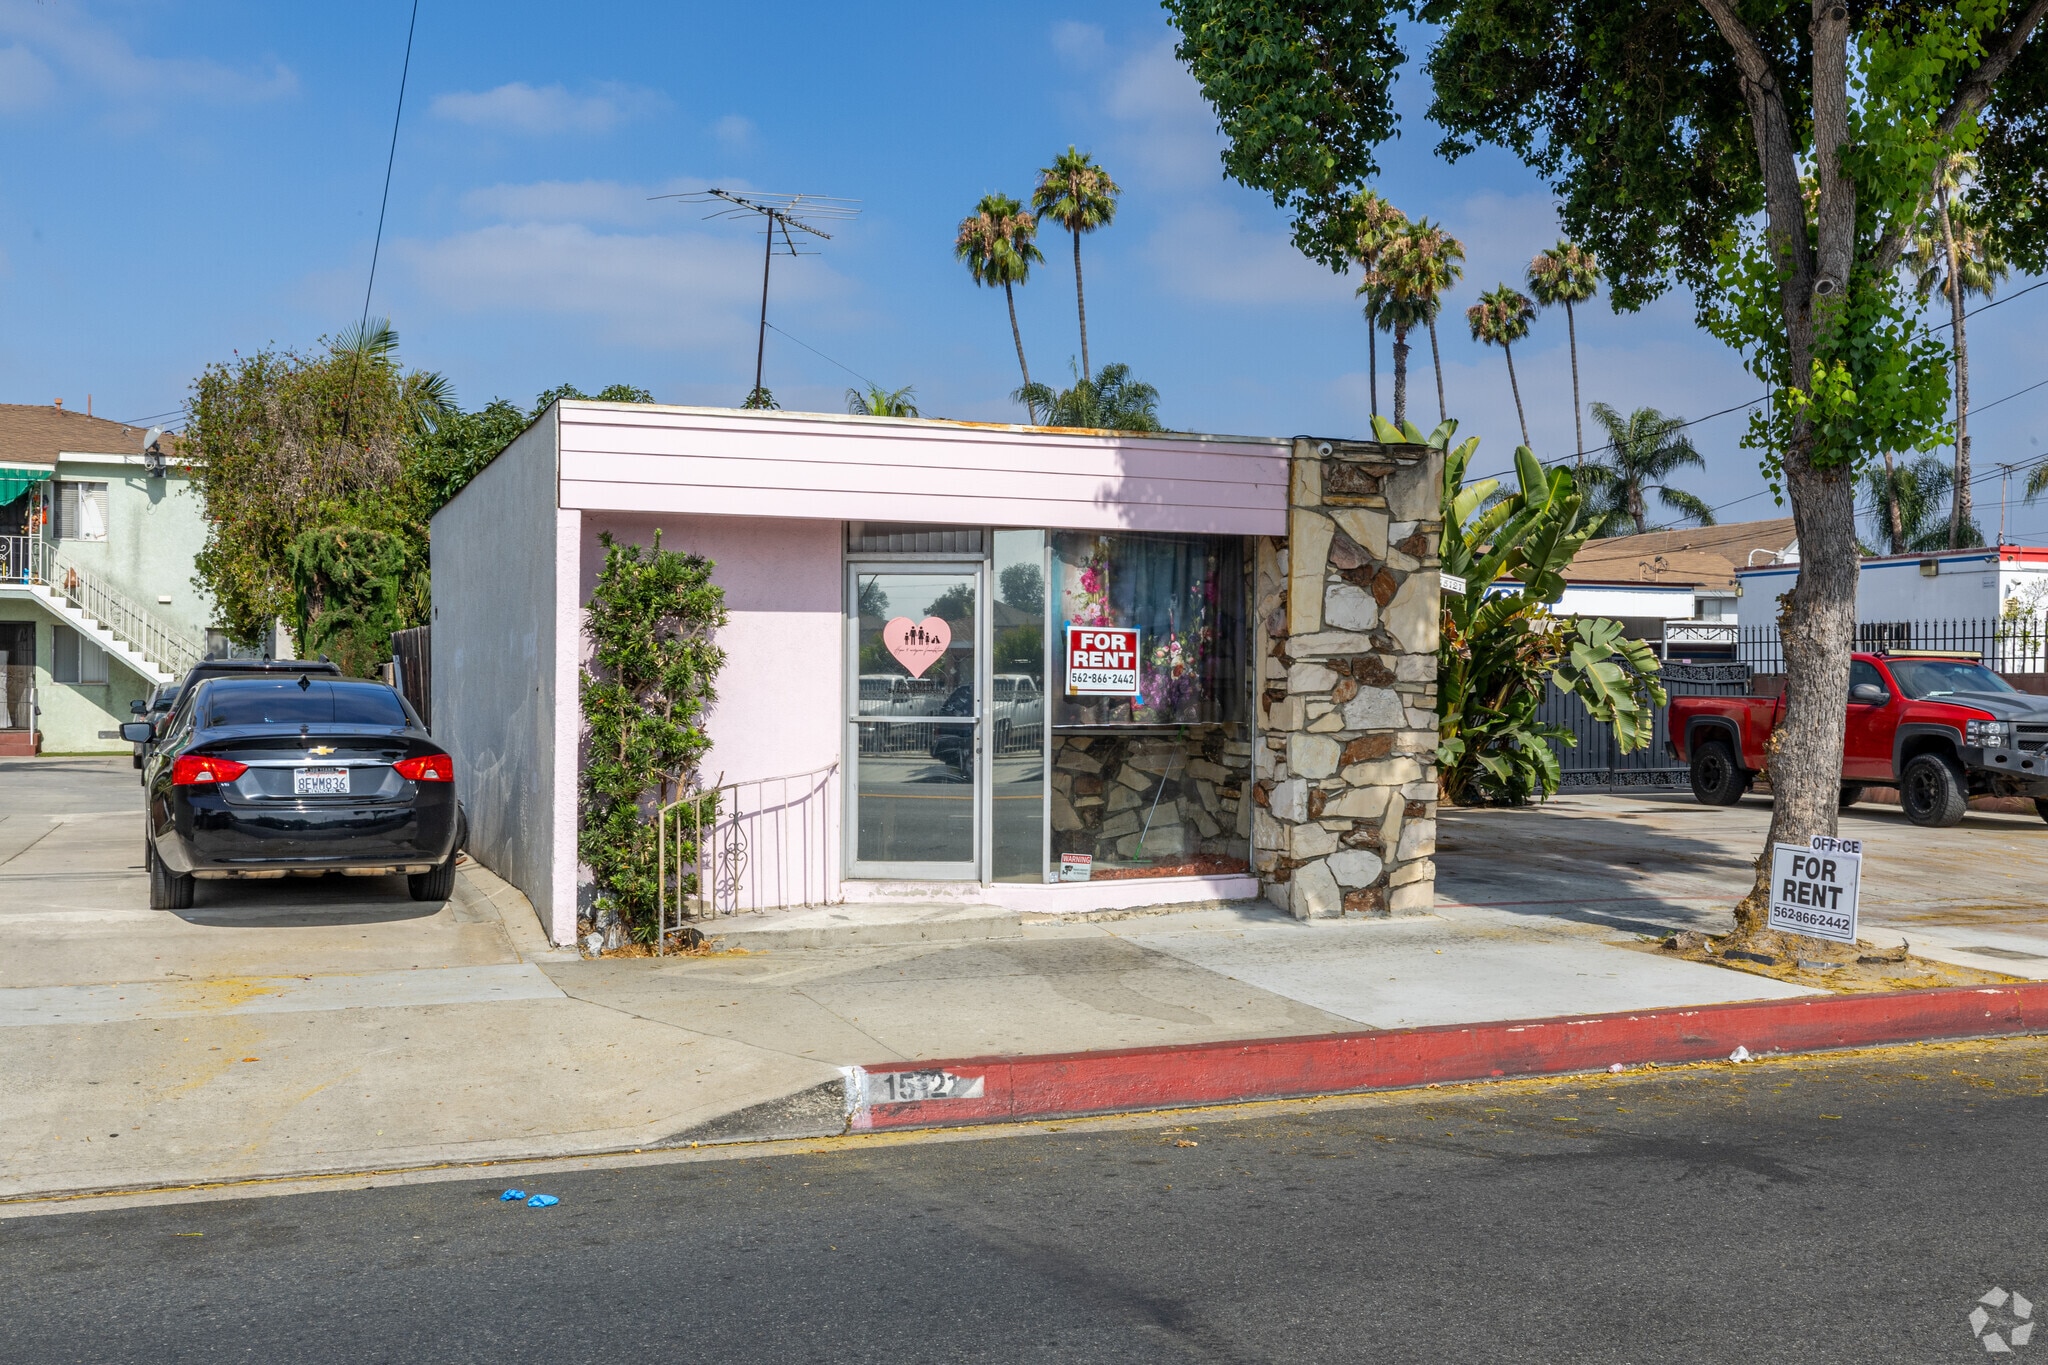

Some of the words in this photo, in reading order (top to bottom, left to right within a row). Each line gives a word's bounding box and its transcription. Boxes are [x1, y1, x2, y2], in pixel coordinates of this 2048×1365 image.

[1081, 633, 1126, 650] FOR
[1073, 651, 1134, 668] RENT
[1072, 673, 1134, 684] 562-866-2442
[298, 777, 346, 790] 8EWM836
[1812, 837, 1860, 853] OFFICE
[1062, 855, 1091, 864] WARNING
[1792, 855, 1837, 882] FOR
[1783, 879, 1843, 910] RENT
[1774, 906, 1850, 931] 562-866-2442
